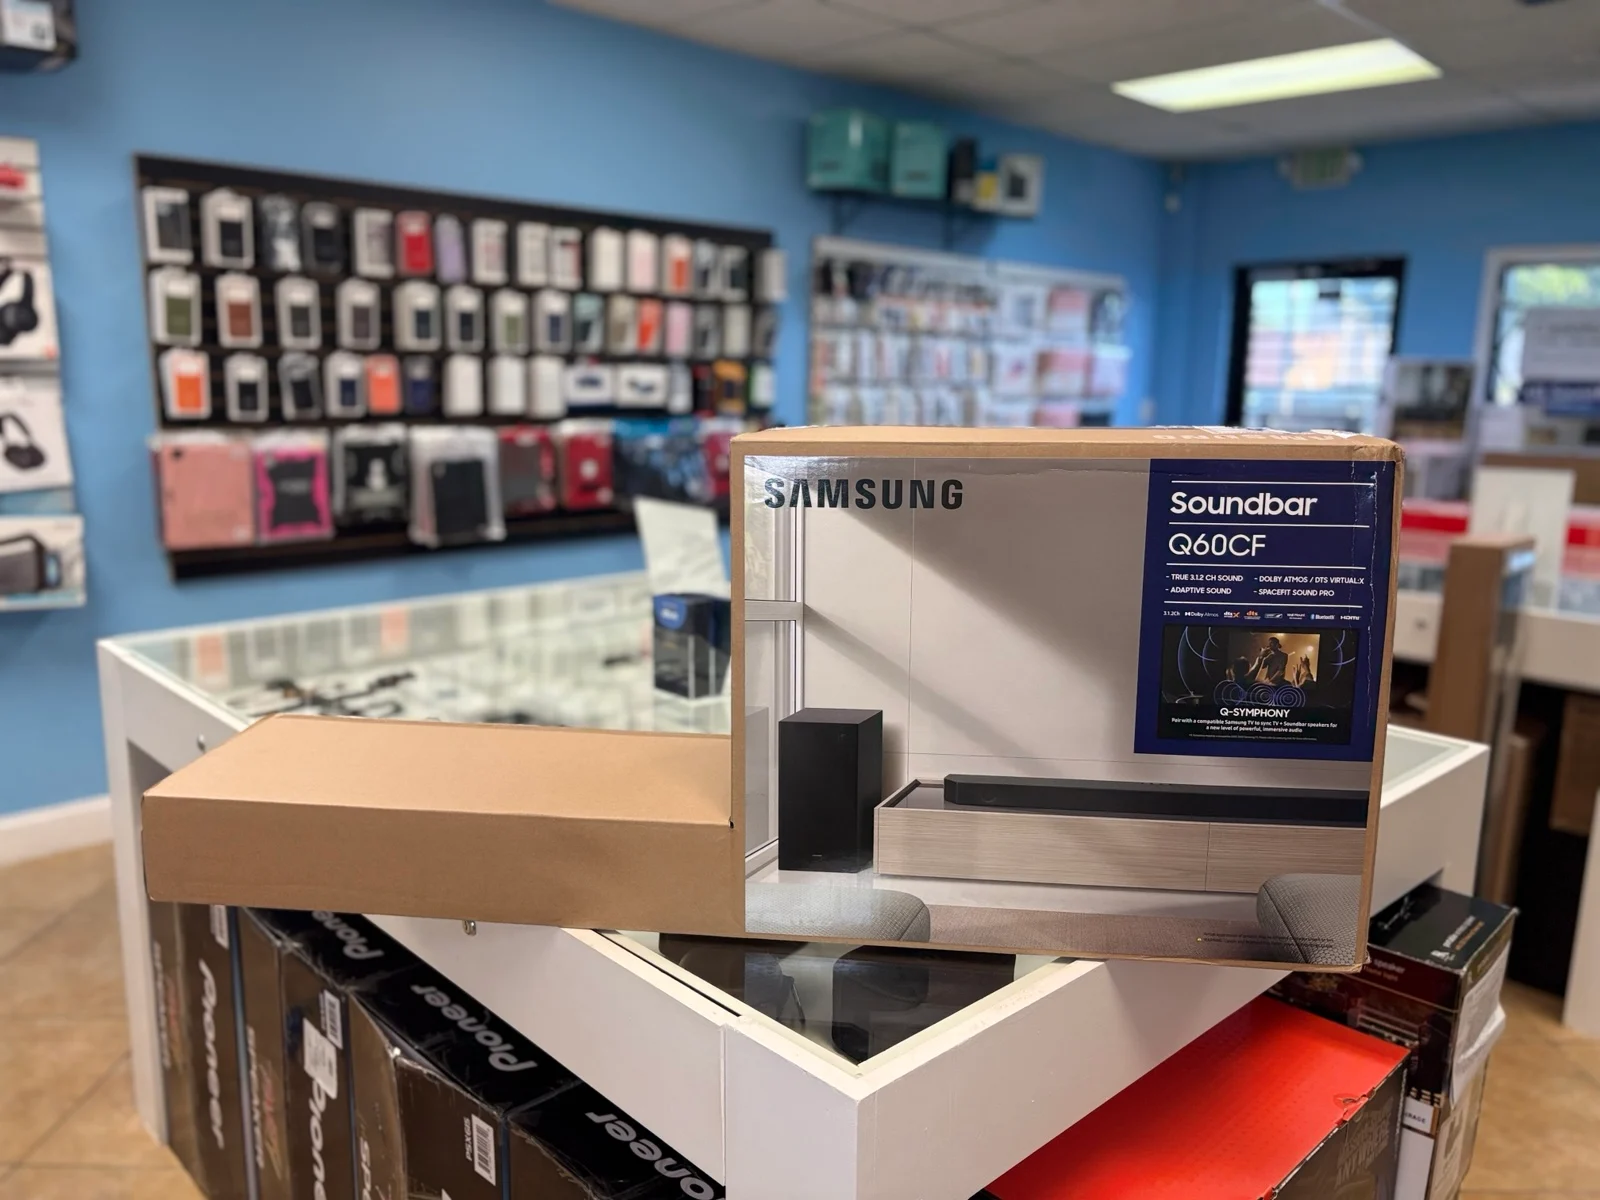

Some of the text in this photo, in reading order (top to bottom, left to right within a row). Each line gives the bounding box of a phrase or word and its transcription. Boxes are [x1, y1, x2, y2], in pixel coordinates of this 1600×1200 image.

[764, 478, 963, 509] SAMSUNG
[1170, 491, 1318, 516] Soundbar
[1168, 532, 1266, 556] Q60CF
[1170, 586, 1205, 594] ADAPTIVE
[1217, 574, 1244, 582] SOUND
[1259, 575, 1283, 583] DOLBY
[1258, 588, 1291, 596] SPACEFIT
[1319, 589, 1335, 597] PRO
[1220, 707, 1290, 718] Q-SYMPHONY
[410, 984, 538, 1072] Pioneer
[199, 957, 225, 1150] Pioneer
[585, 1112, 726, 1200] oneer
